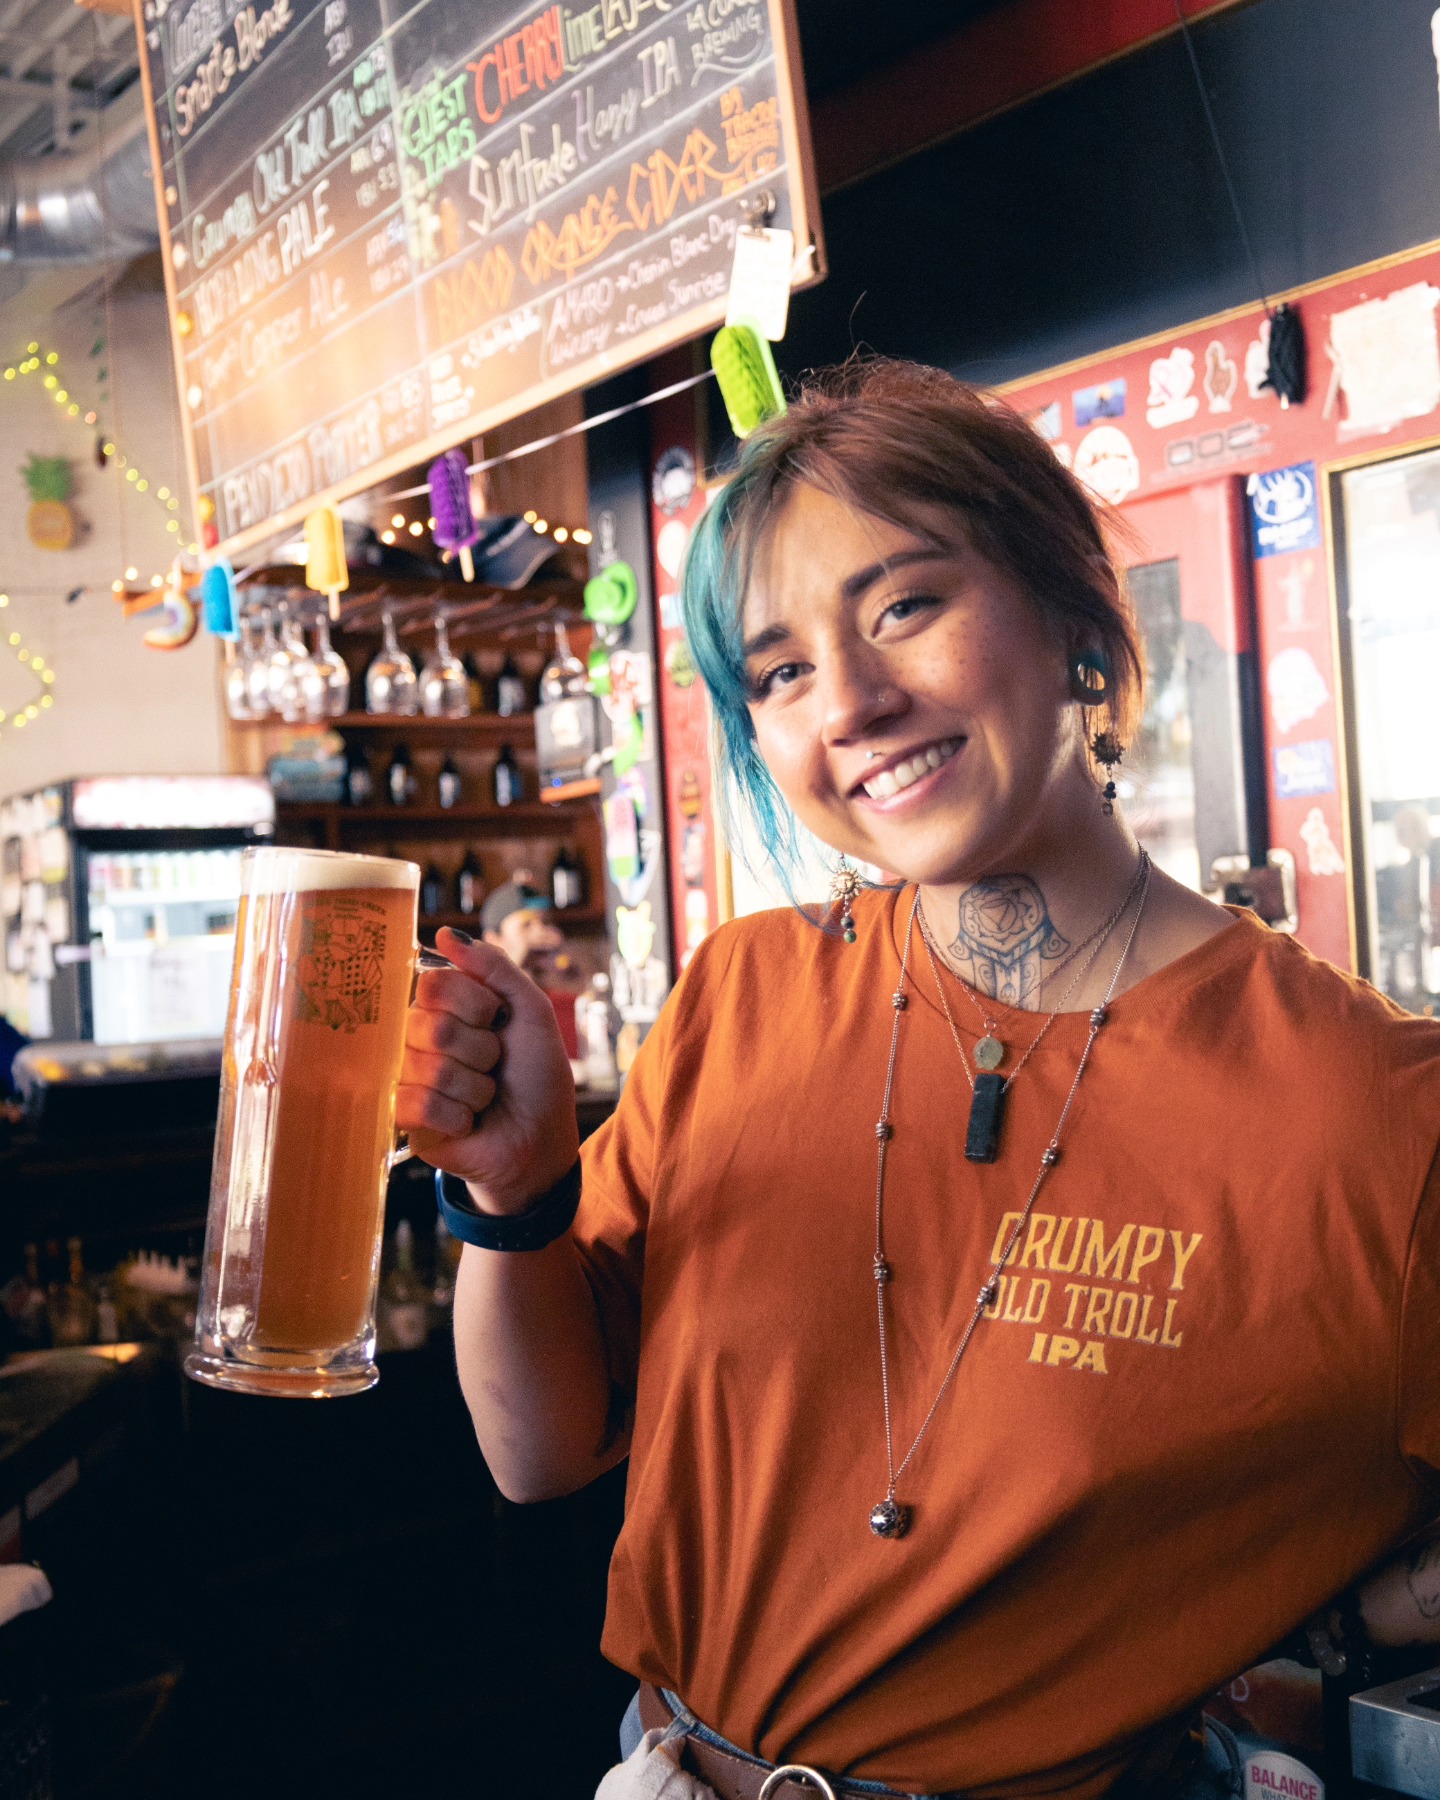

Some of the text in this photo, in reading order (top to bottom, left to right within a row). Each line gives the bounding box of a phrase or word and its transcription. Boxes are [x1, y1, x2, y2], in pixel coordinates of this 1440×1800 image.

[466, 5, 563, 124] CHERRY
[637, 36, 682, 108] IPA
[691, 6, 764, 67] BREWING
[403, 73, 467, 157] GUEST
[420, 118, 476, 188] TAPS
[277, 179, 335, 275] PALE
[520, 186, 625, 284] ORANGE
[991, 1211, 1203, 1290] GRUMPY
[1063, 1283, 1183, 1348] TROLL
[1028, 1332, 1108, 1374] IPA
[1252, 1765, 1317, 1800] BALANCE
